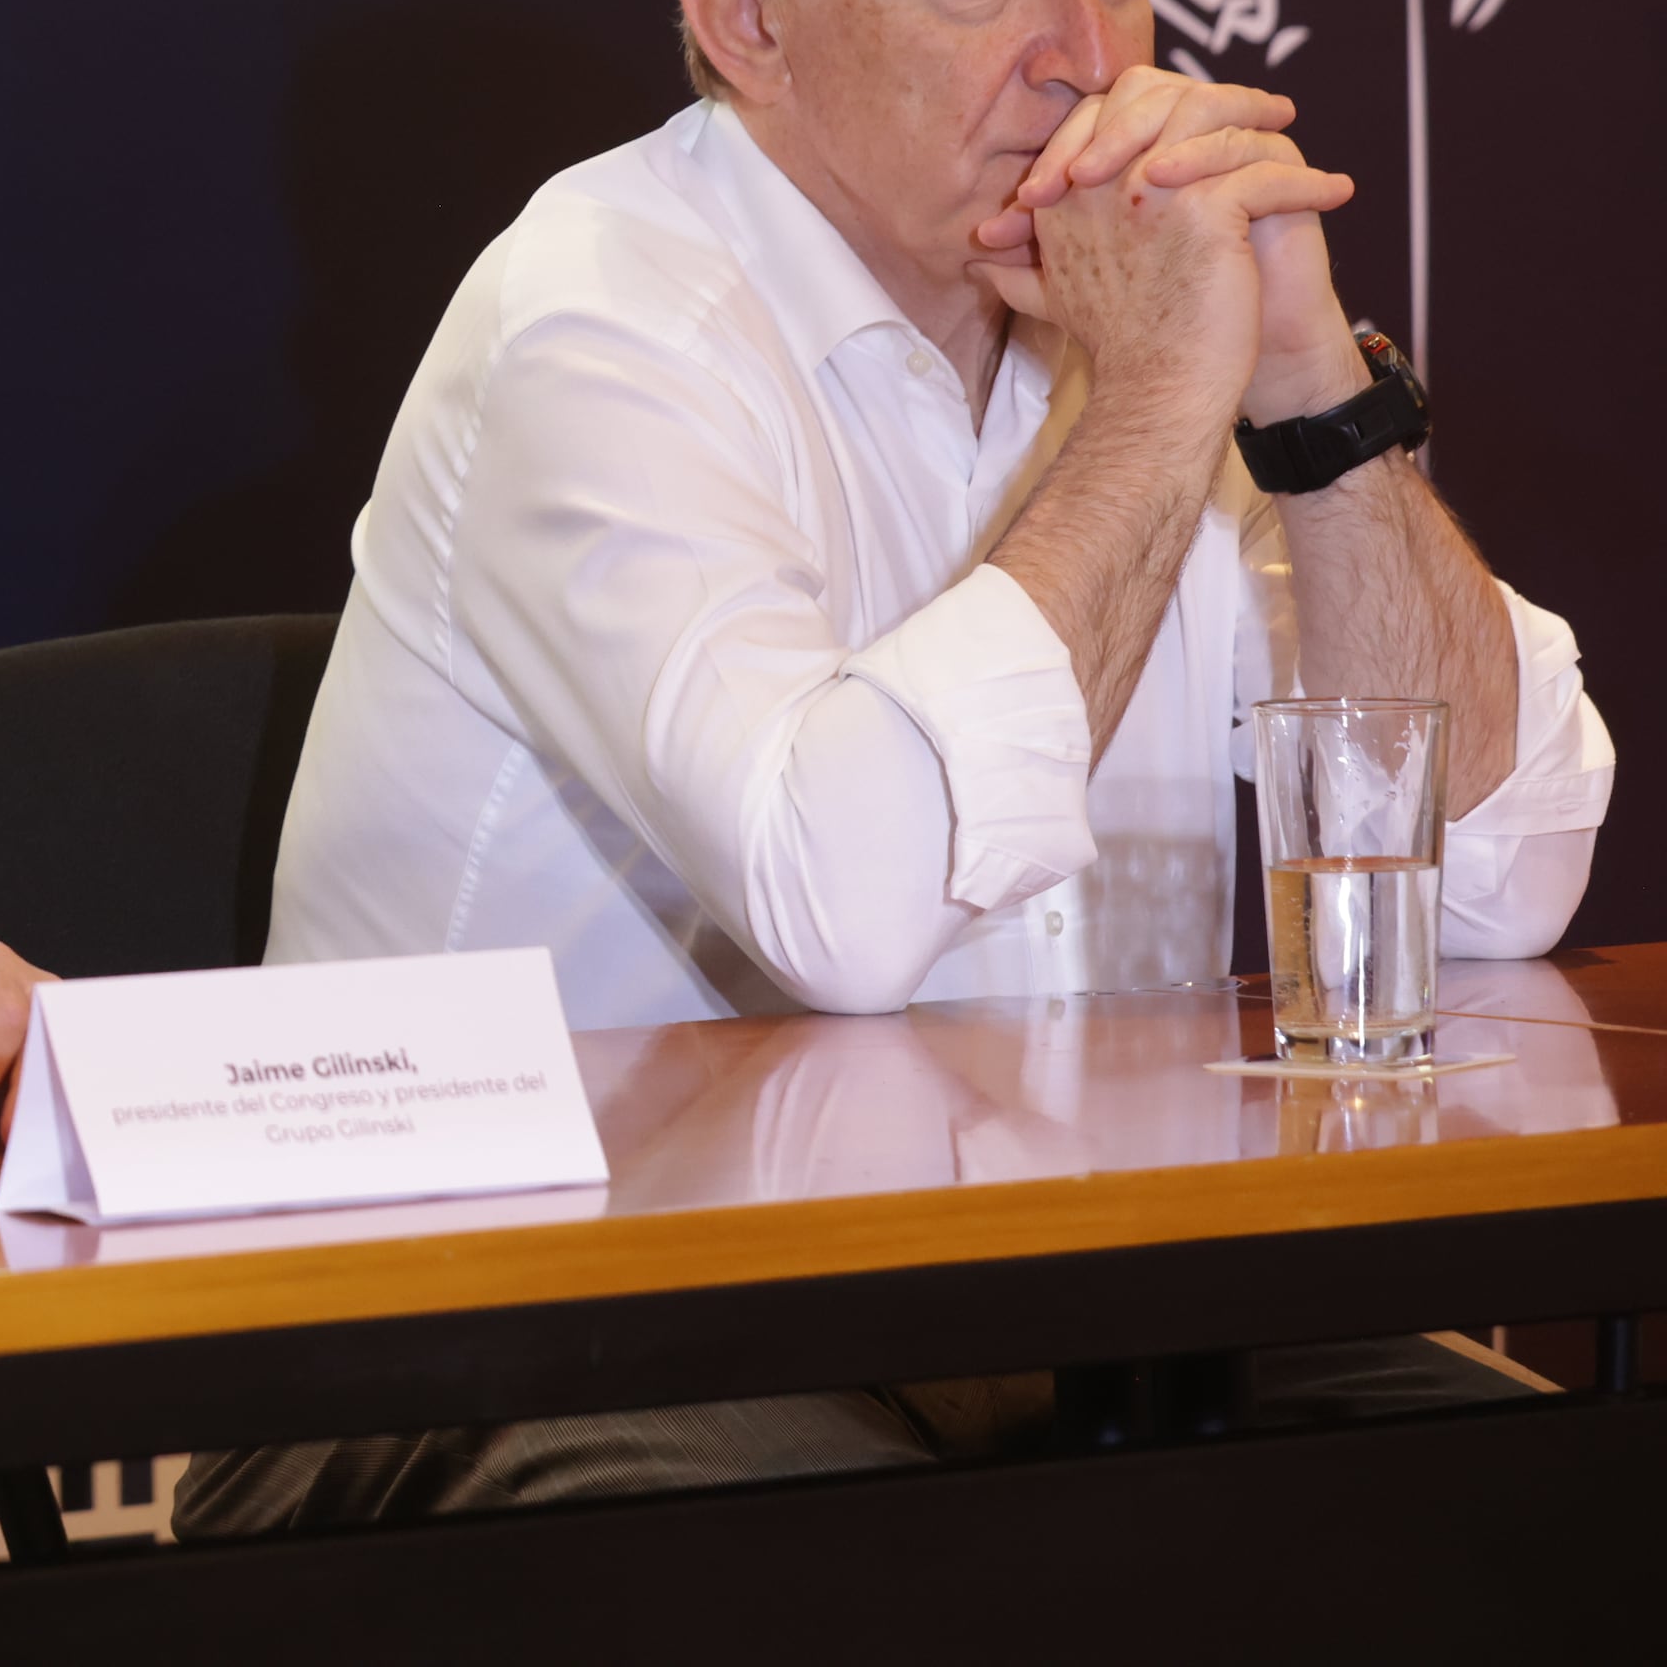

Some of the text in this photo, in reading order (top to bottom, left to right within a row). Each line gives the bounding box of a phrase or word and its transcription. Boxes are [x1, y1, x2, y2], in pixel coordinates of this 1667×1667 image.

[225, 1046, 419, 1086] Jaime Gilinski,
[112, 1069, 547, 1127] presidente del Congreso y presidente del
[265, 1115, 415, 1147] Grupo Gilinski
